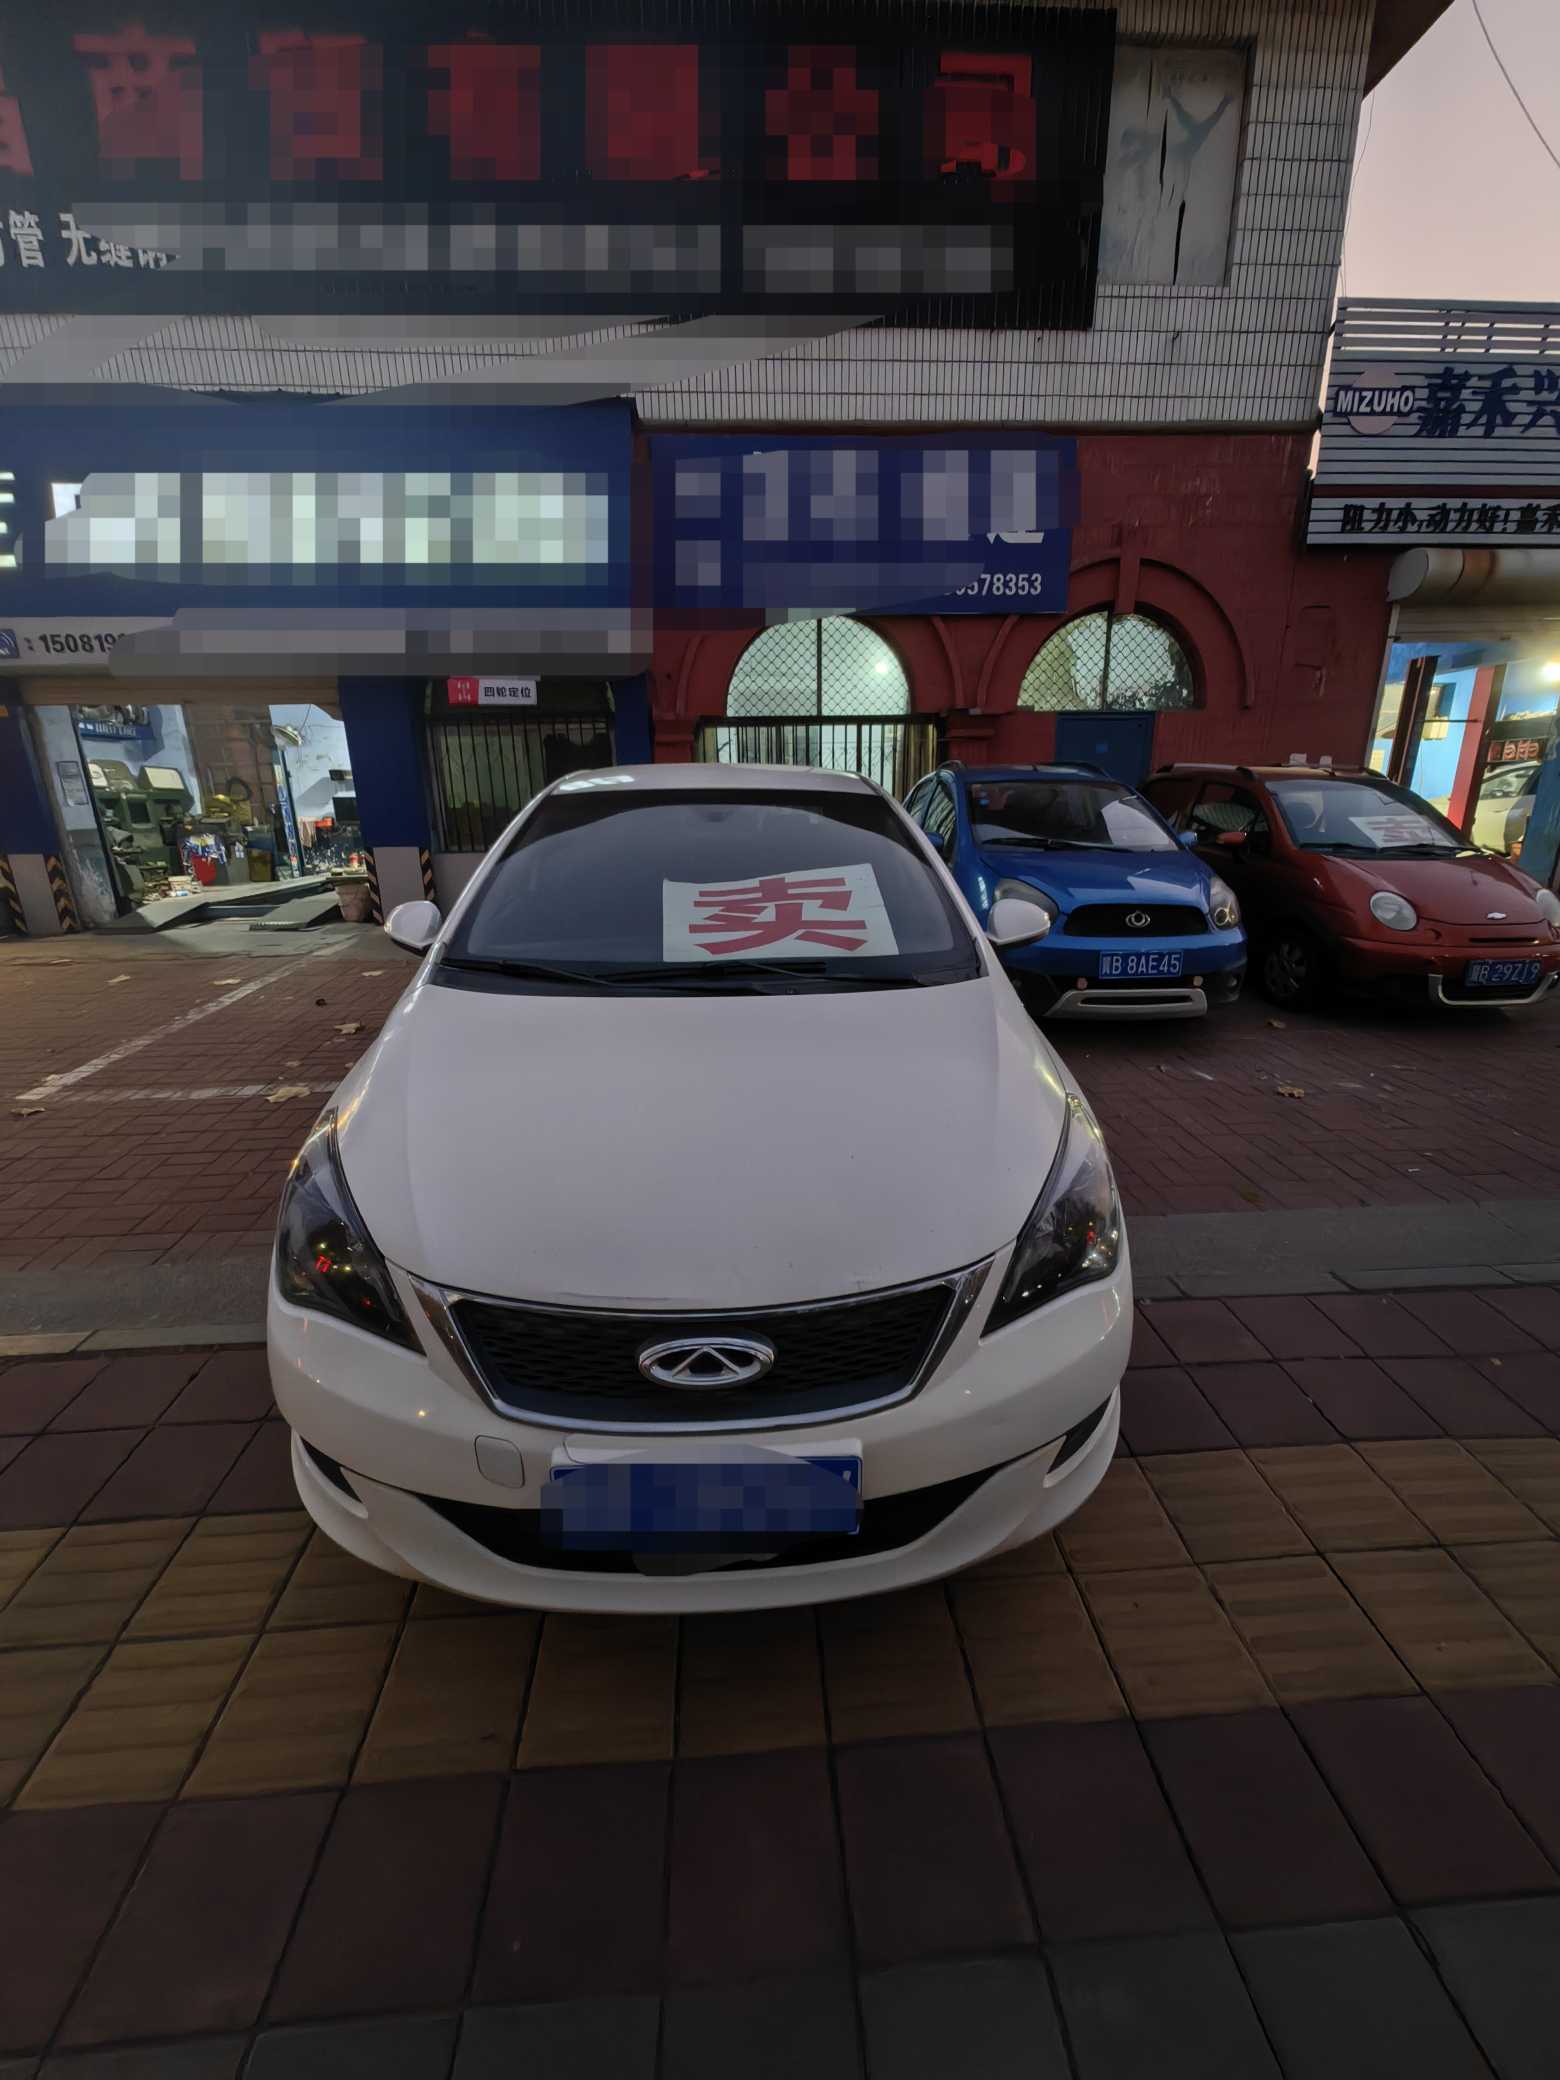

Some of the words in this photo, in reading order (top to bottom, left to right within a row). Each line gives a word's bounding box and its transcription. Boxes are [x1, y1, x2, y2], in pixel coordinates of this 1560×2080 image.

[1335, 389, 1414, 414] MIZUHO
[484, 686, 532, 699] 四轮定位
[688, 877, 868, 956] 卖
